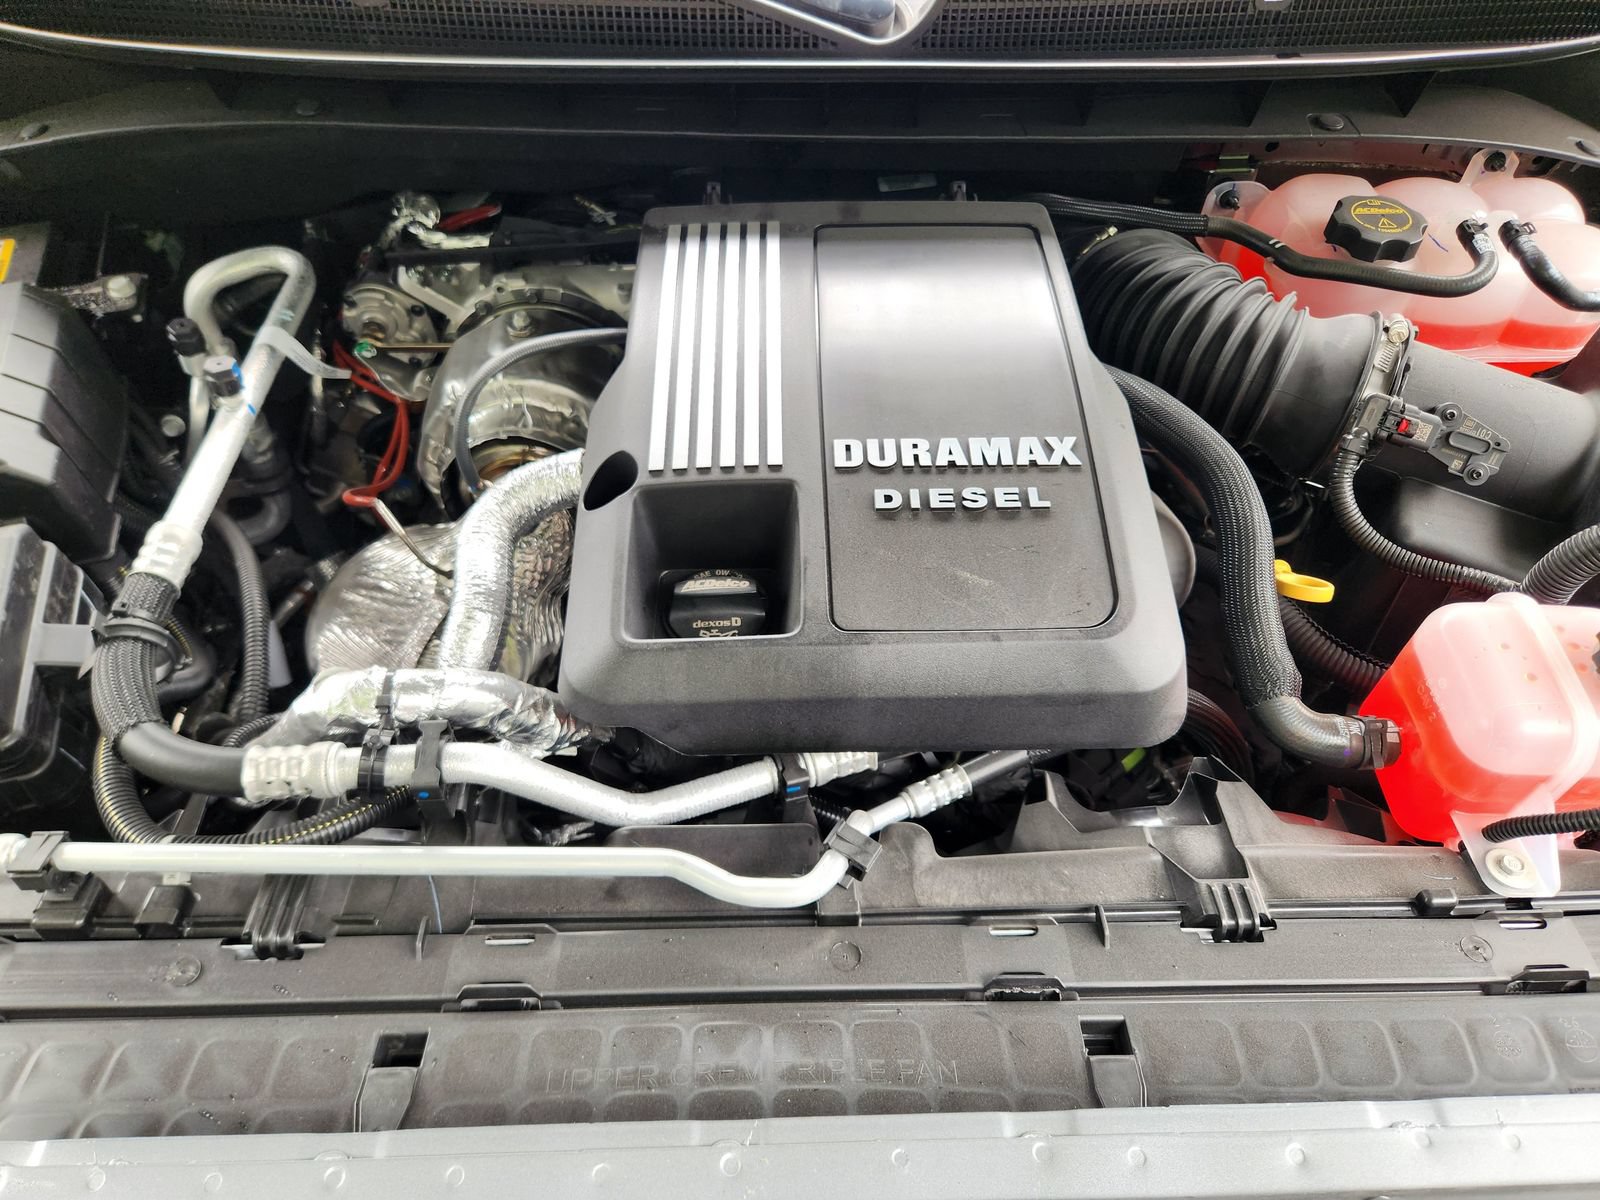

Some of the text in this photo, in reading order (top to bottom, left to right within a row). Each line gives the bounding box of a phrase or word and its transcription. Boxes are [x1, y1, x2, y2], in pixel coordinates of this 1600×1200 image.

[832, 436, 1083, 468] DURAMAX
[874, 486, 1052, 512] DIESEL
[680, 578, 750, 593] ACDelco
[546, 1063, 659, 1098] UPPER
[776, 1057, 886, 1083] TRIPLE
[898, 1058, 959, 1086] FAN
